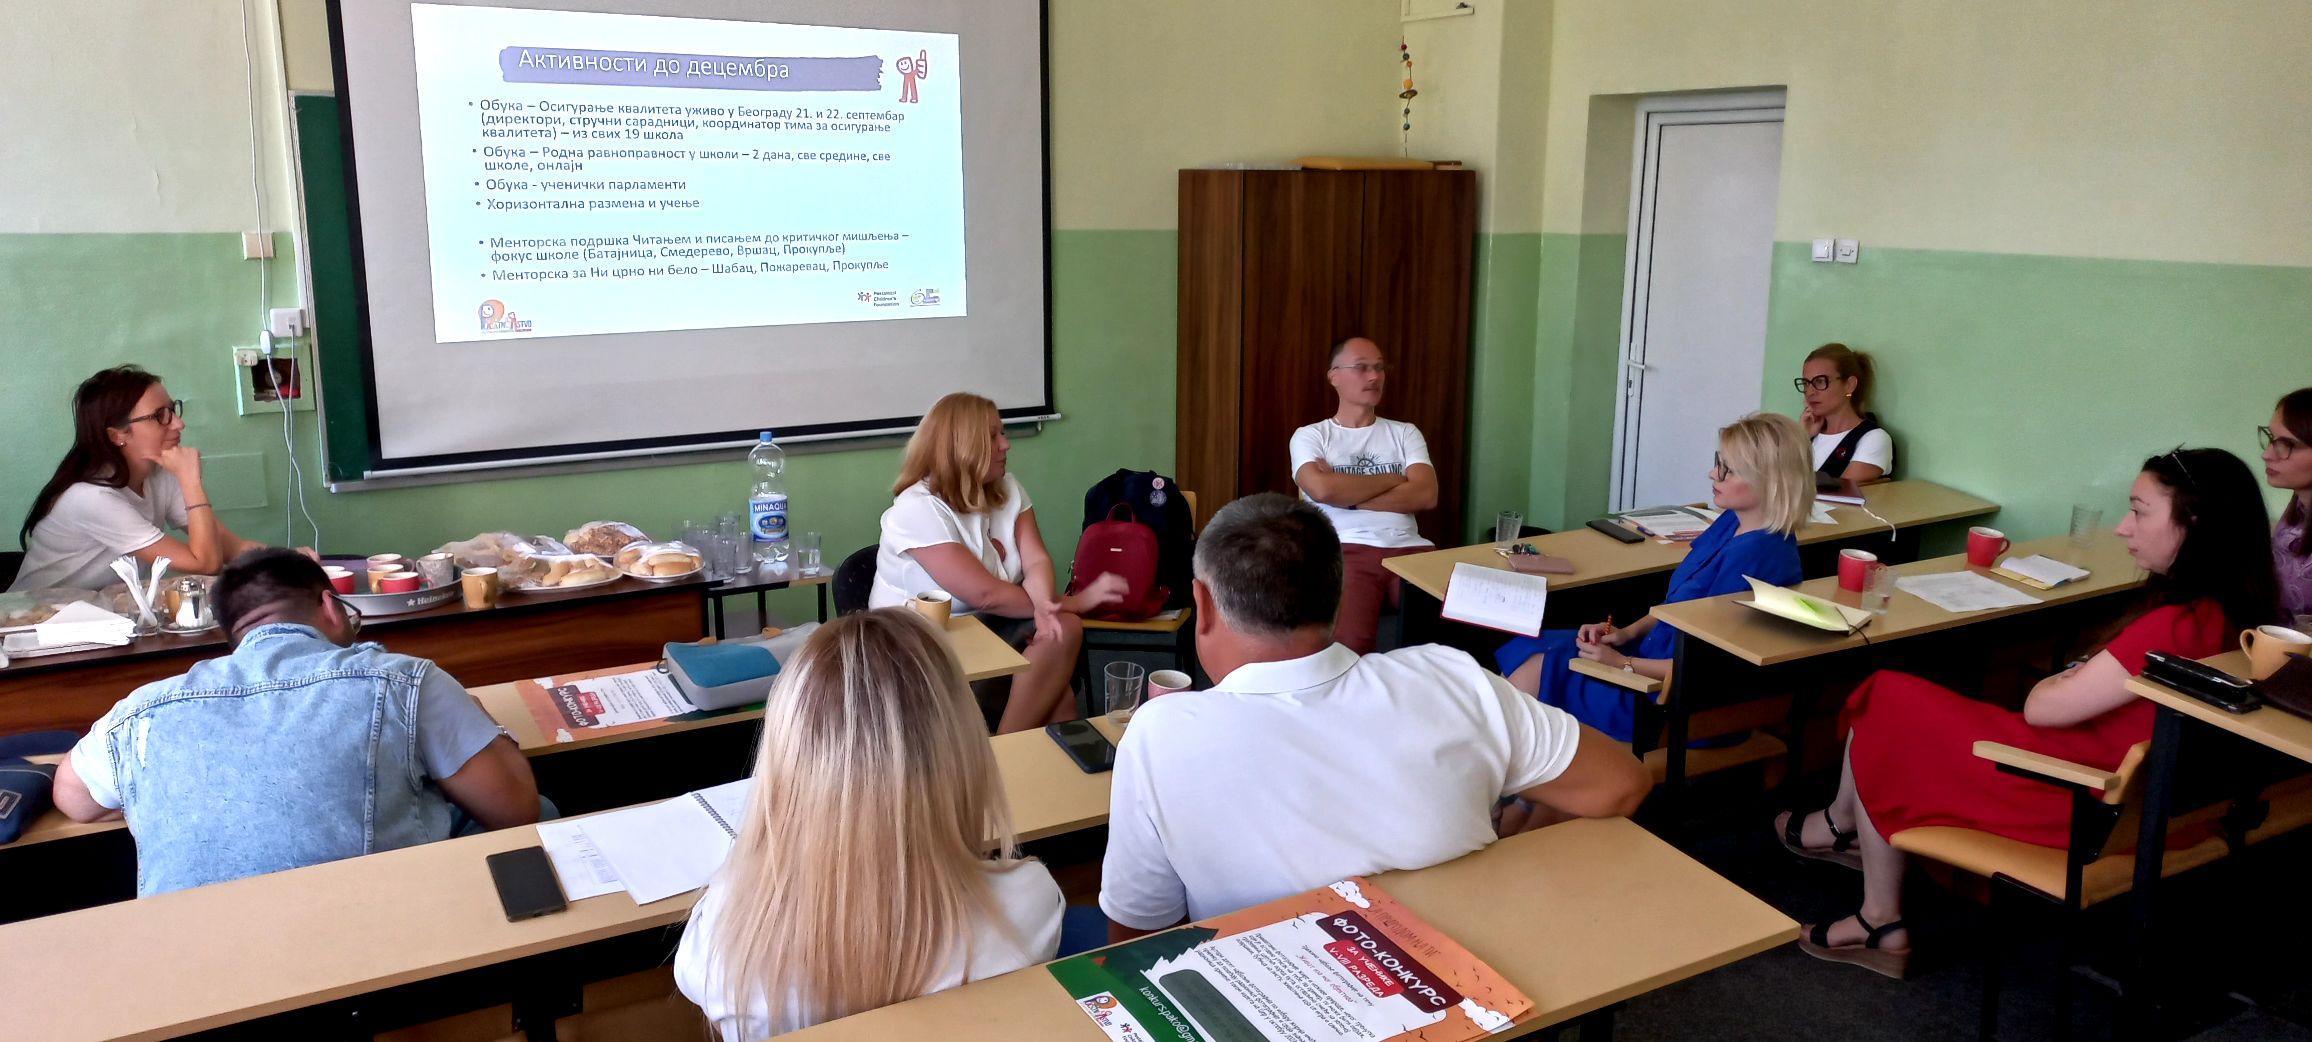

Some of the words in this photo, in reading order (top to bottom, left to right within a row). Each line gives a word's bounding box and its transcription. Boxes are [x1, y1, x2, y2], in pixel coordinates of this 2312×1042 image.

[518, 50, 647, 72] Активности
[654, 59, 680, 76] до
[686, 58, 790, 81] децембра
[480, 99, 523, 113] Обука
[539, 101, 614, 114] Осигурање
[618, 104, 682, 115] квалитета
[685, 106, 725, 117] уживо
[728, 108, 734, 118] у
[738, 106, 793, 120] Београду
[796, 108, 813, 119] 21.
[816, 111, 823, 119] и
[826, 109, 843, 120] 22.
[846, 111, 905, 123] септембар
[481, 113, 565, 126] (директори,
[570, 116, 622, 127] стручни
[625, 118, 699, 129] сарадници,
[703, 120, 781, 131] координатор
[785, 122, 813, 130] тима
[831, 124, 891, 133] осигурање
[482, 127, 557, 140] квалитета)
[573, 130, 588, 138] из
[592, 131, 620, 139] свих
[625, 129, 639, 139] 19
[643, 131, 684, 140] школа
[484, 146, 526, 159] Обука
[543, 147, 583, 159] Родна
[588, 149, 685, 160] равноправност
[689, 151, 696, 160] у
[700, 151, 739, 159] школи
[752, 150, 759, 159] 2
[763, 152, 794, 162] дана,
[797, 152, 817, 160] све
[820, 153, 870, 162] средине,
[872, 153, 890, 161] све
[485, 162, 532, 172] школе,
[538, 160, 583, 173] онлајн
[486, 179, 528, 192] Обука
[541, 181, 604, 191] ученички
[609, 181, 686, 191] парламенти
[487, 199, 585, 212] Хоризонтална
[589, 200, 645, 211] размена
[660, 200, 700, 210] учење
[490, 237, 566, 249] Менторска
[571, 237, 629, 248] подршка
[633, 234, 691, 246] Читањем
[695, 235, 702, 243] и
[706, 235, 761, 244] писањем
[765, 235, 779, 244] до
[783, 233, 839, 244] критичког
[842, 232, 899, 241] мишљења
[491, 250, 532, 263] фокус
[537, 251, 579, 260] школе
[584, 247, 656, 262] (Батајница,
[660, 244, 734, 259] Смедерево,
[737, 245, 779, 257] Вршац,
[784, 243, 845, 255] Прокупље)
[493, 270, 569, 281] Менторска
[572, 270, 586, 278] за
[591, 267, 608, 278] Ни
[613, 268, 645, 278] црно
[668, 265, 698, 275] бело
[712, 263, 757, 275] Шабац,
[761, 262, 829, 273] Пожаревац,
[833, 260, 889, 272] Прокупље
[1333, 917, 1447, 1007] ФОТО-КОНКУРС
[1347, 946, 1359, 956] ЗА
[1358, 956, 1395, 987] УЧЕНИКЕ
[1349, 965, 1385, 997] РАЗРЕДА
